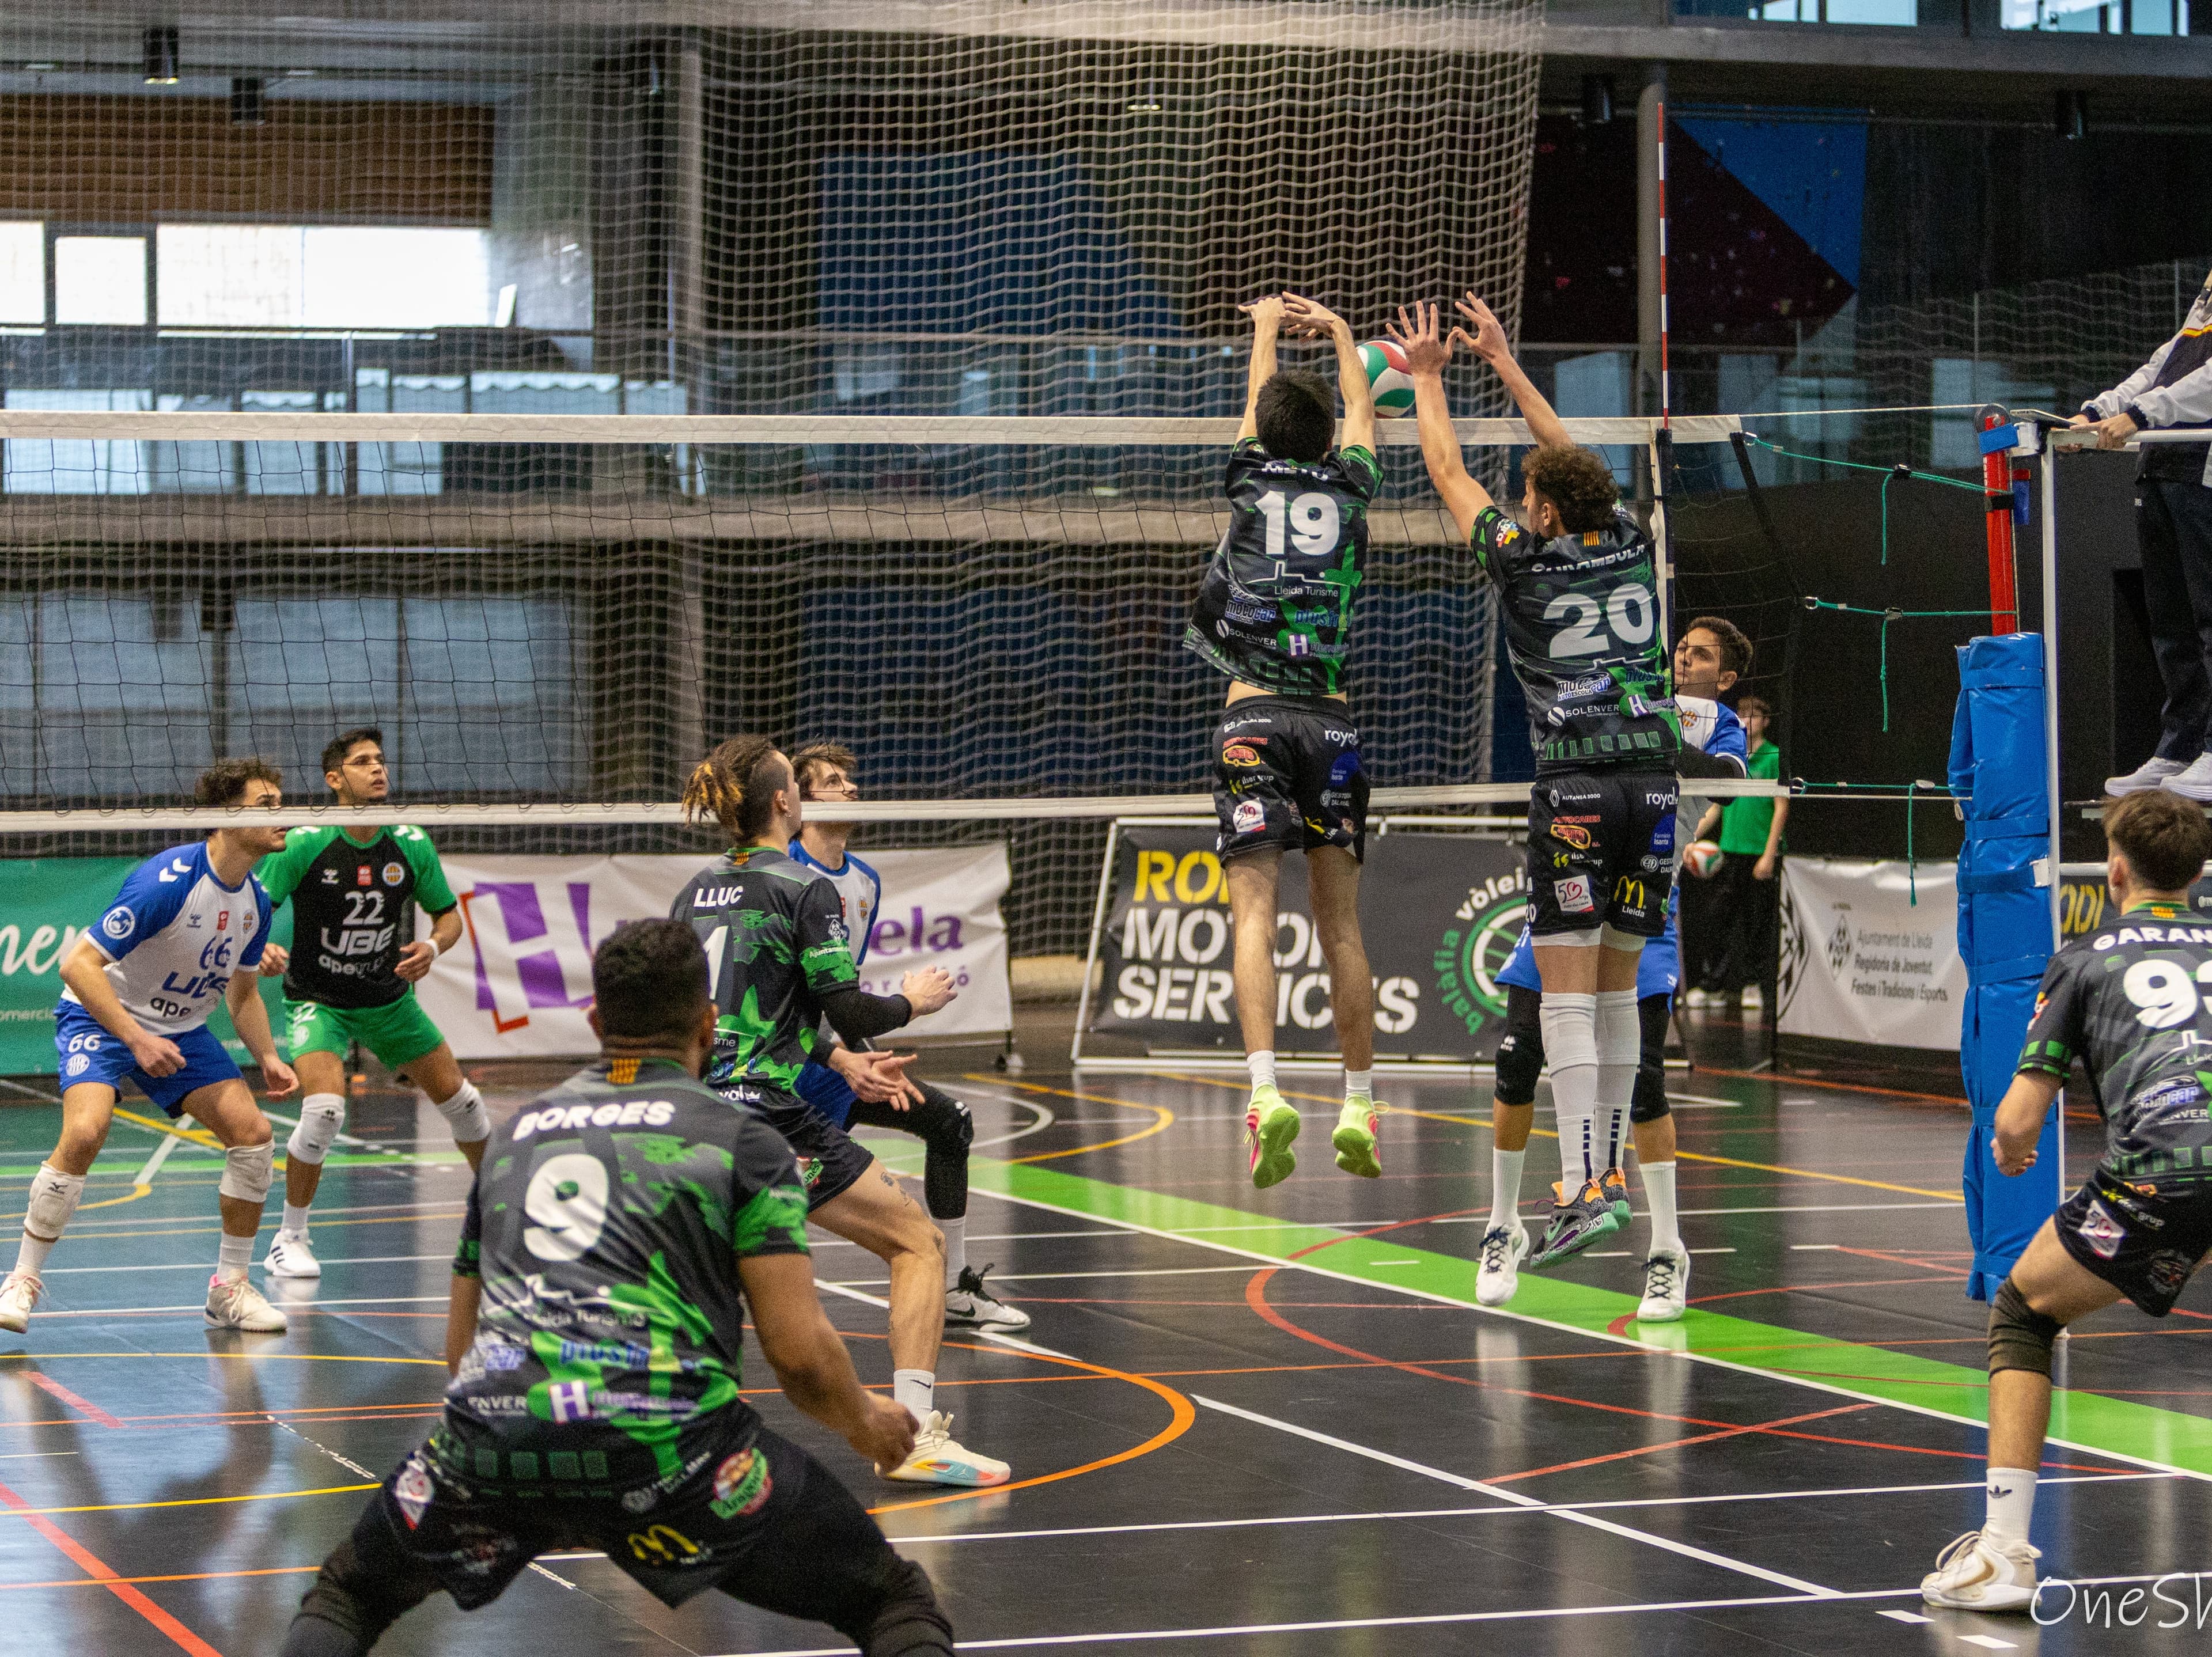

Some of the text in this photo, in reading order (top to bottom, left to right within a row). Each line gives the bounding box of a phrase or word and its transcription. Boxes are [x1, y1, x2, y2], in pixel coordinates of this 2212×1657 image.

[1254, 490, 1340, 556] 19
[1274, 586, 1339, 597] Lleida Turisme
[1543, 583, 1653, 658] 20
[1229, 628, 1277, 646] SOLENVER
[1558, 689, 1594, 702] AUTOESCOLA
[1565, 704, 1620, 717] SOLENVER
[693, 886, 744, 908] LLUC
[343, 891, 385, 926] 22
[1622, 905, 1645, 918] Lleida
[320, 923, 395, 956] UBE
[67, 1034, 100, 1053] 66
[513, 1101, 675, 1141] BORGES
[524, 1154, 608, 1261] 9
